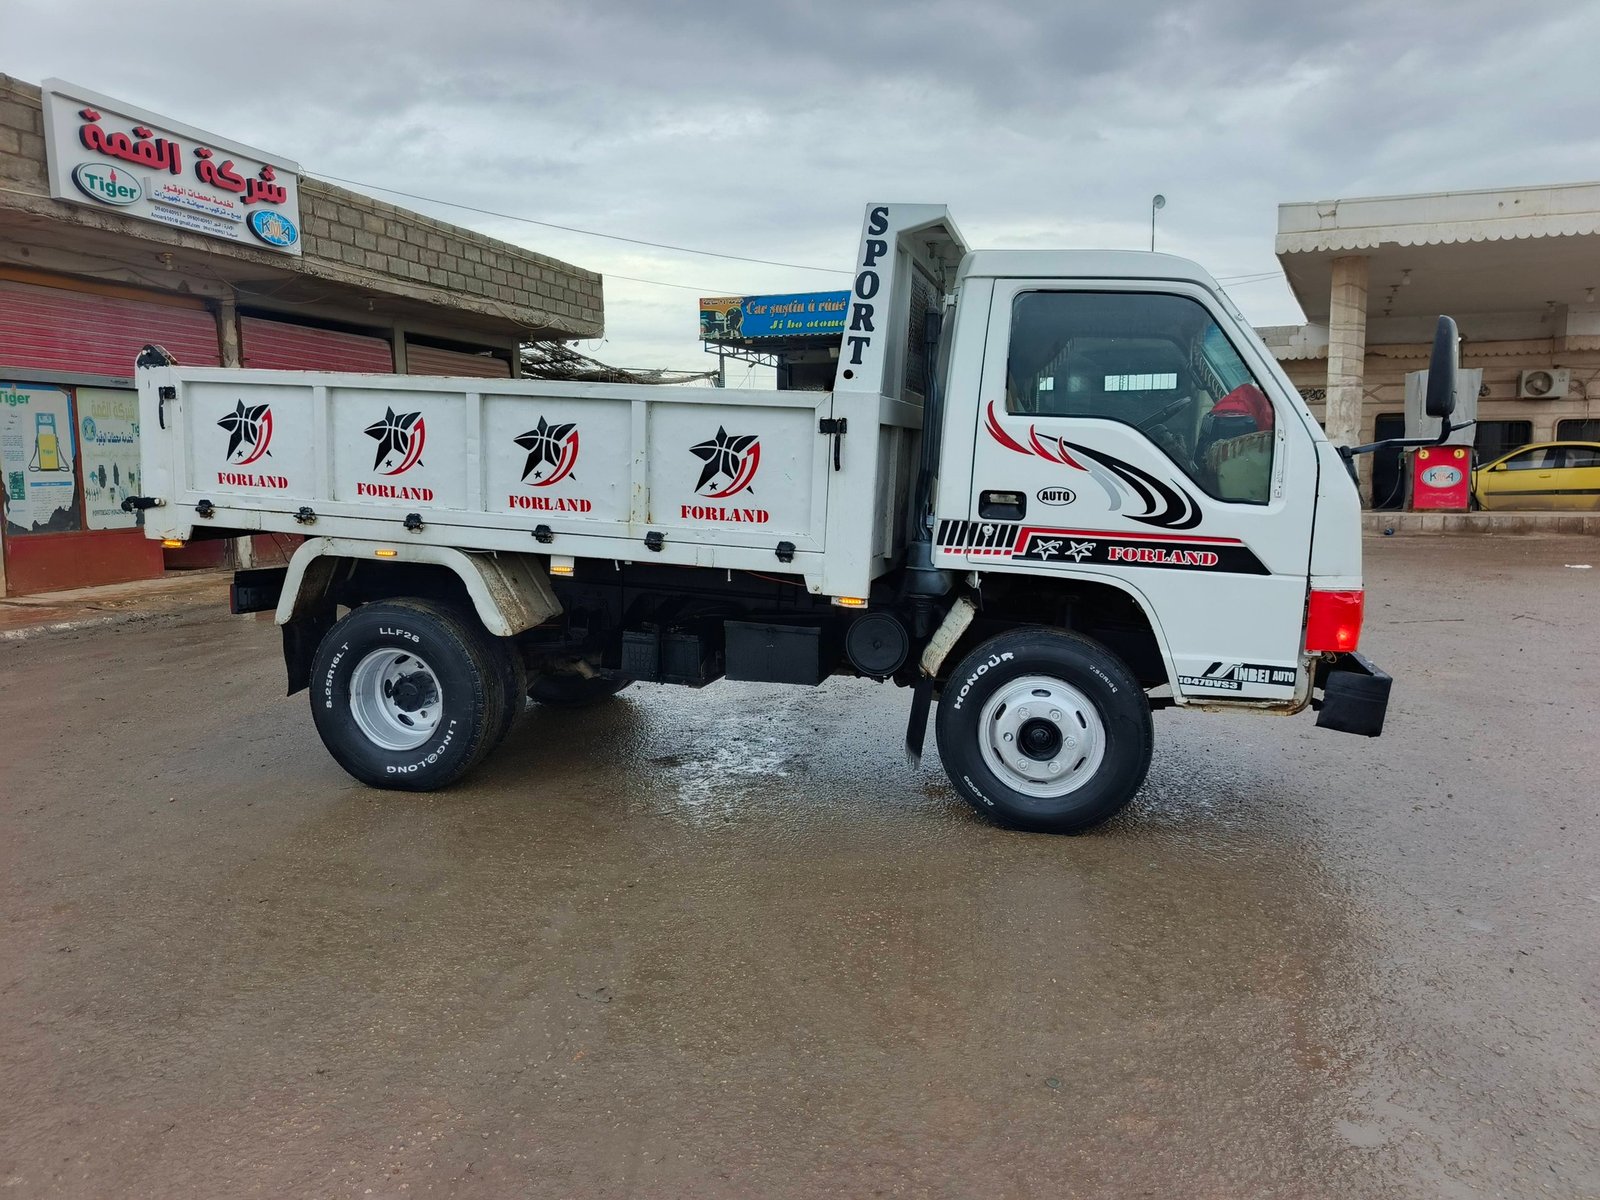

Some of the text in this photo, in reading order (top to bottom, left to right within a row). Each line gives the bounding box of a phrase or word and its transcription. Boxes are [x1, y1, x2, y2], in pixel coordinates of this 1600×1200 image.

[79, 107, 287, 204] شركة القمة
[84, 172, 136, 199] Tiger
[847, 206, 889, 365] SPORT
[746, 300, 768, 315] Car
[807, 299, 815, 312] û
[770, 319, 783, 330] Ji
[787, 319, 802, 329] bo
[217, 472, 288, 489] FORLAND
[356, 482, 434, 501] FORLAND
[1042, 491, 1070, 501] AUTO
[508, 495, 592, 513] FORLAND
[680, 504, 769, 524] FORLAND
[1107, 546, 1218, 566] FORLAND
[379, 627, 420, 643] LLF26
[954, 652, 1014, 710] HONOUR
[1272, 671, 1294, 683] AUTO
